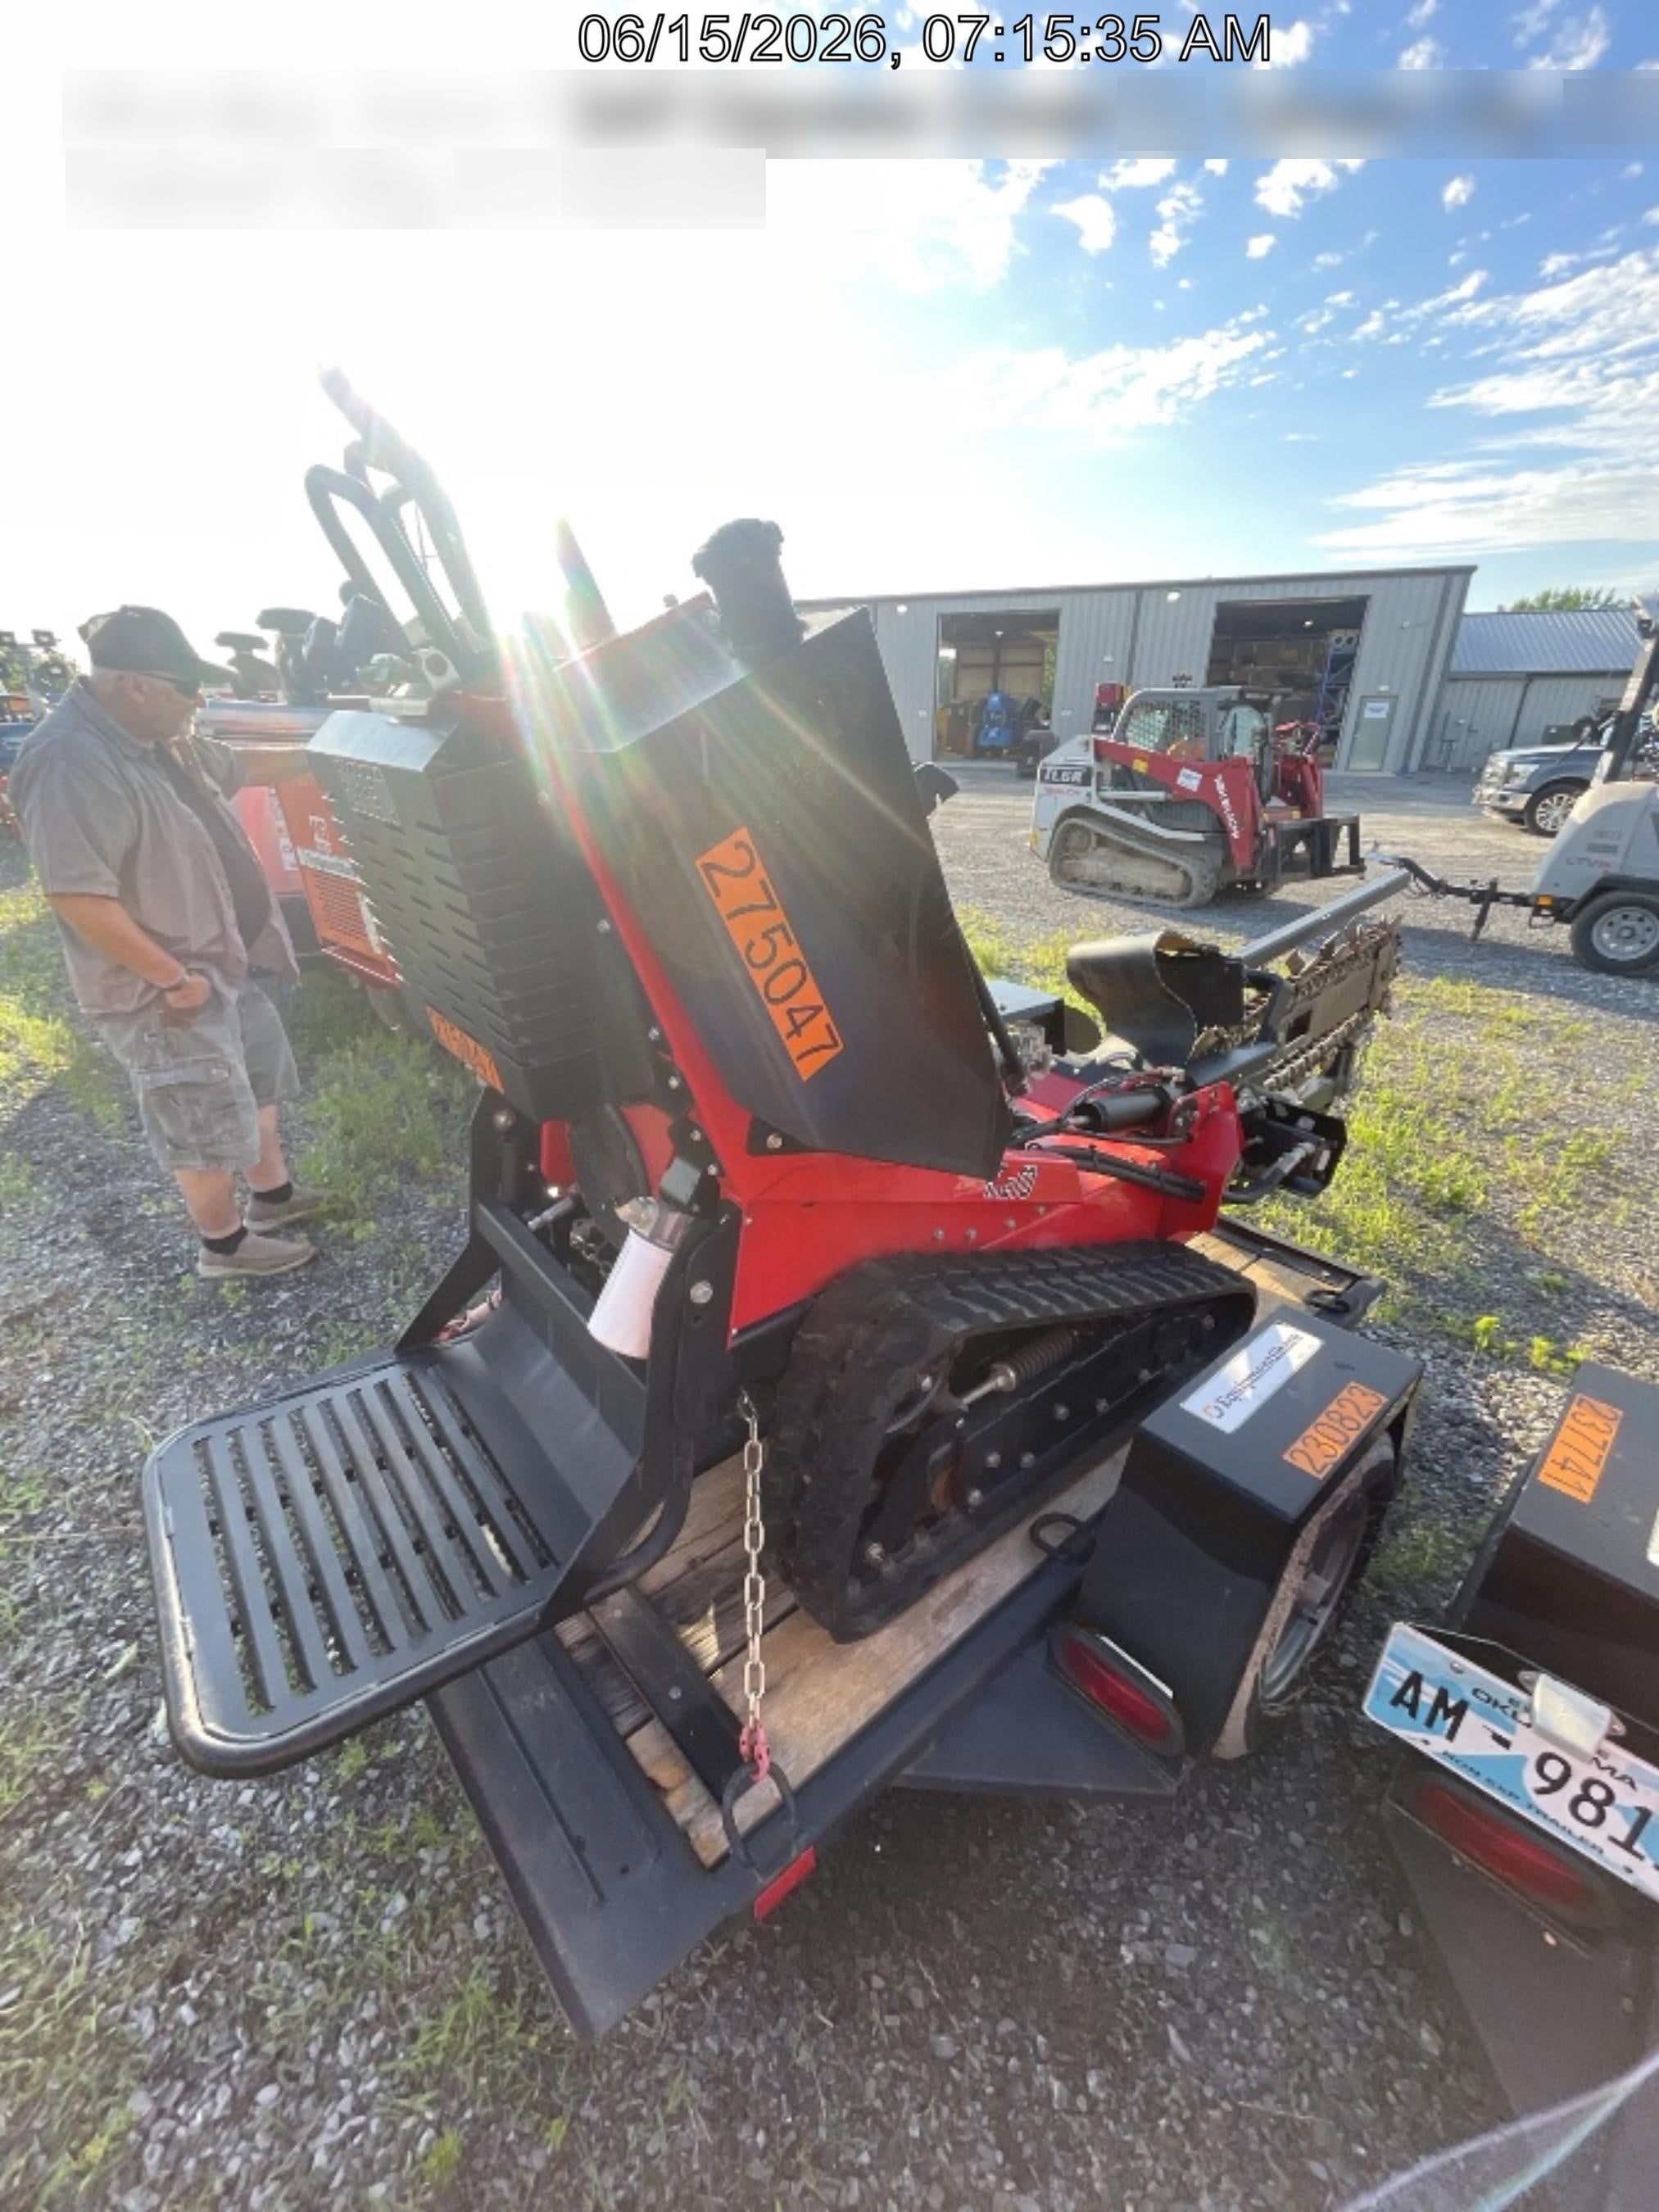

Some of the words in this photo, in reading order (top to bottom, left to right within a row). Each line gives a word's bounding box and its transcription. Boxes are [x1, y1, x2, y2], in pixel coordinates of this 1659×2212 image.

[700, 840, 840, 1063] 275047
[1288, 1385, 1383, 1475] 230823
[1543, 1398, 1619, 1495] 237741
